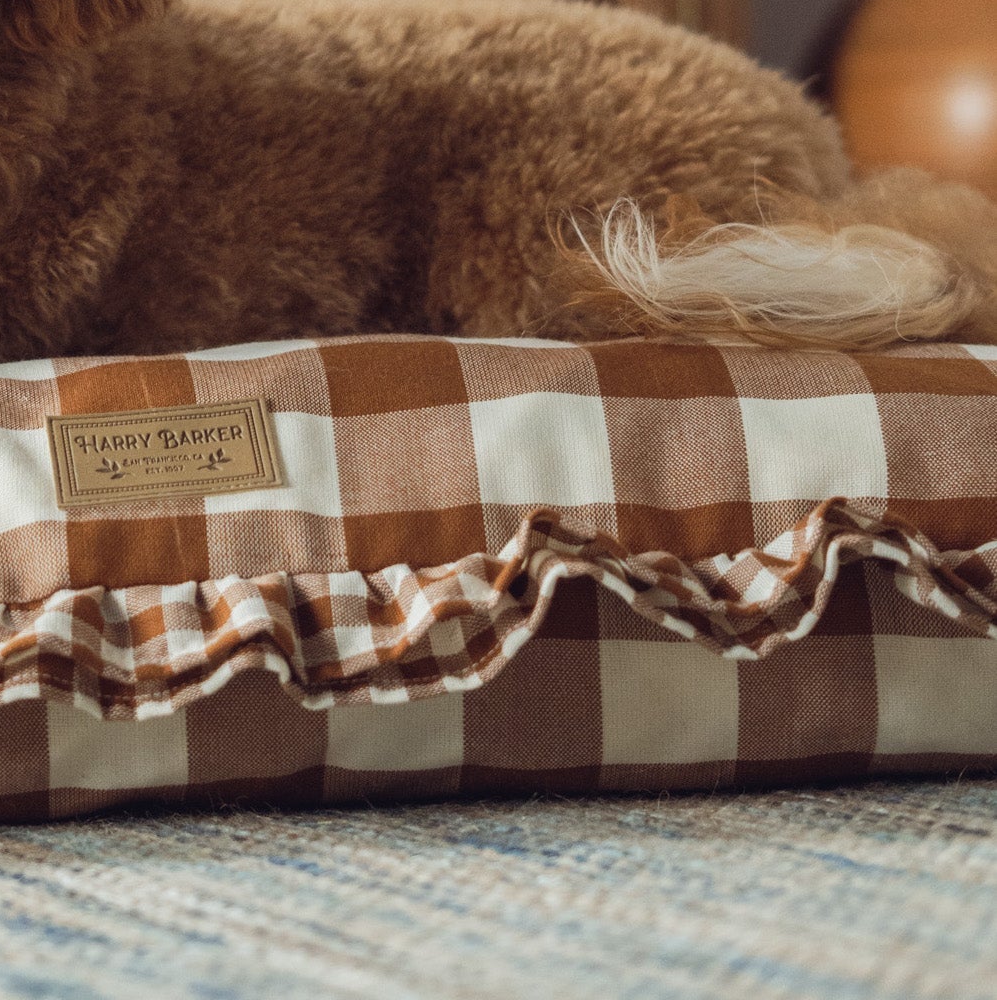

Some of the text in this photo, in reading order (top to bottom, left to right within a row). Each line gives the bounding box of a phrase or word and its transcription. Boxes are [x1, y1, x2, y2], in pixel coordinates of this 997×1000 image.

[74, 424, 244, 455] HARRY BARKER
[122, 458, 142, 467] SAN
